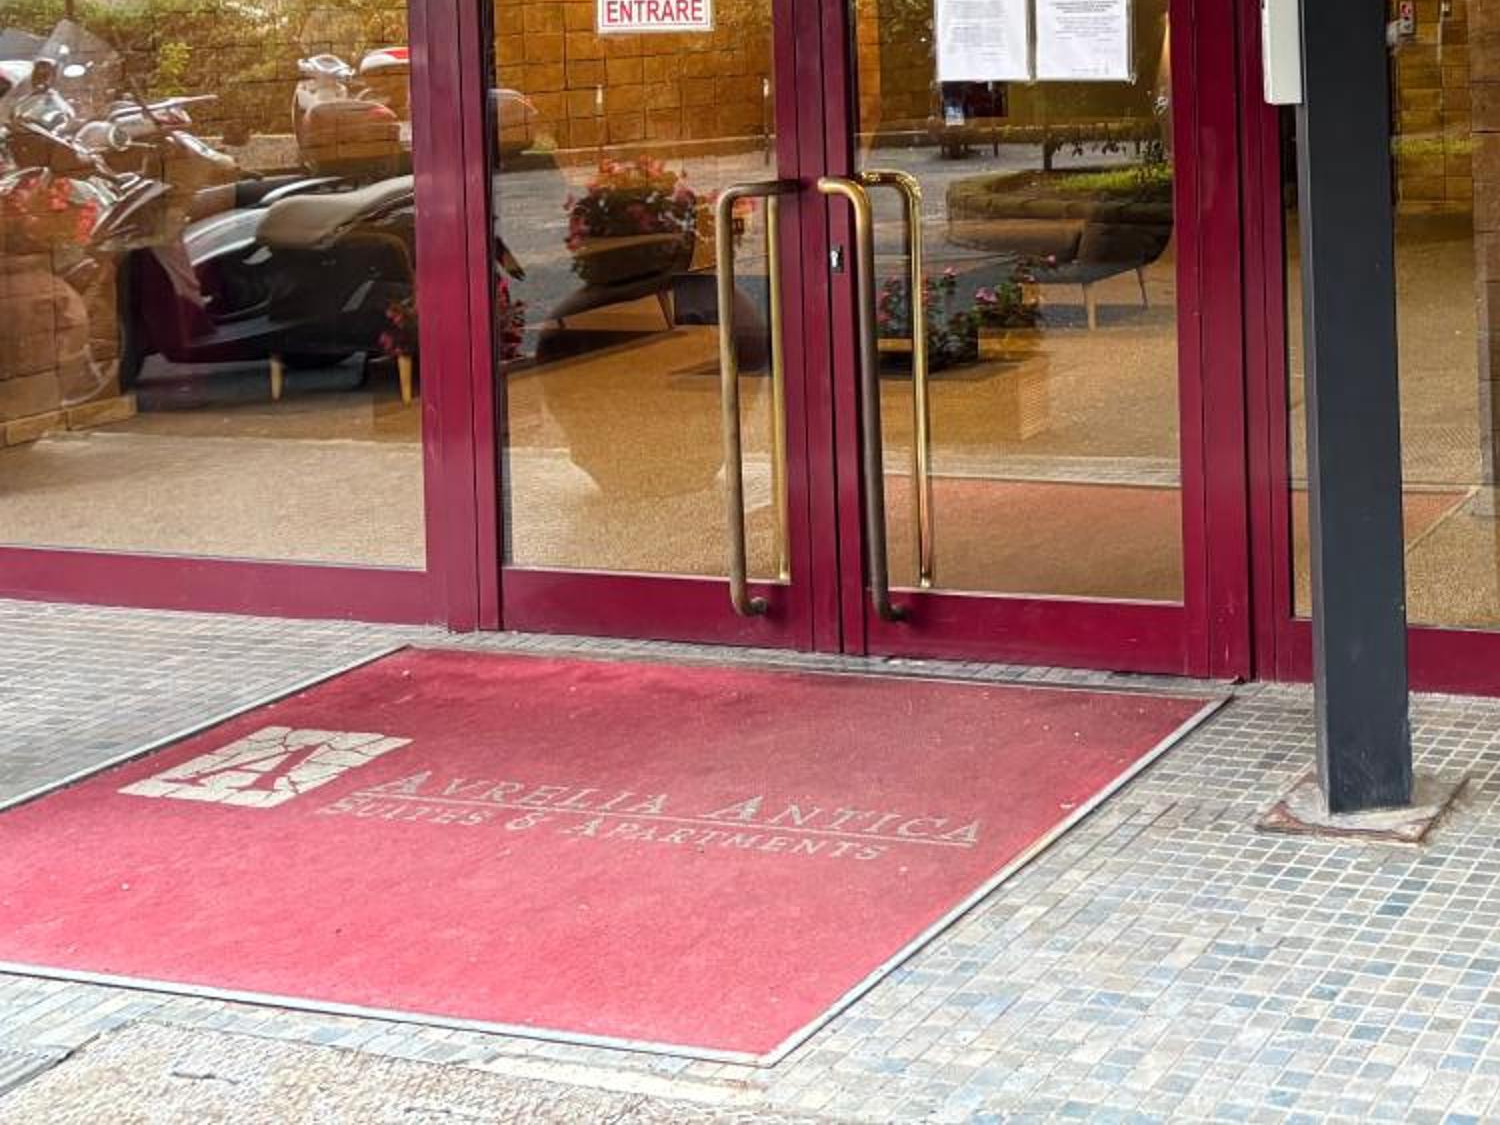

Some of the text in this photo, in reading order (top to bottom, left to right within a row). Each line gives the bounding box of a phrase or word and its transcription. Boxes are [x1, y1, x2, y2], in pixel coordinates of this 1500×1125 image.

[314, 795, 890, 861] SUITES & APARTMENTS
[351, 770, 983, 843] AVRELIA ANTICA
